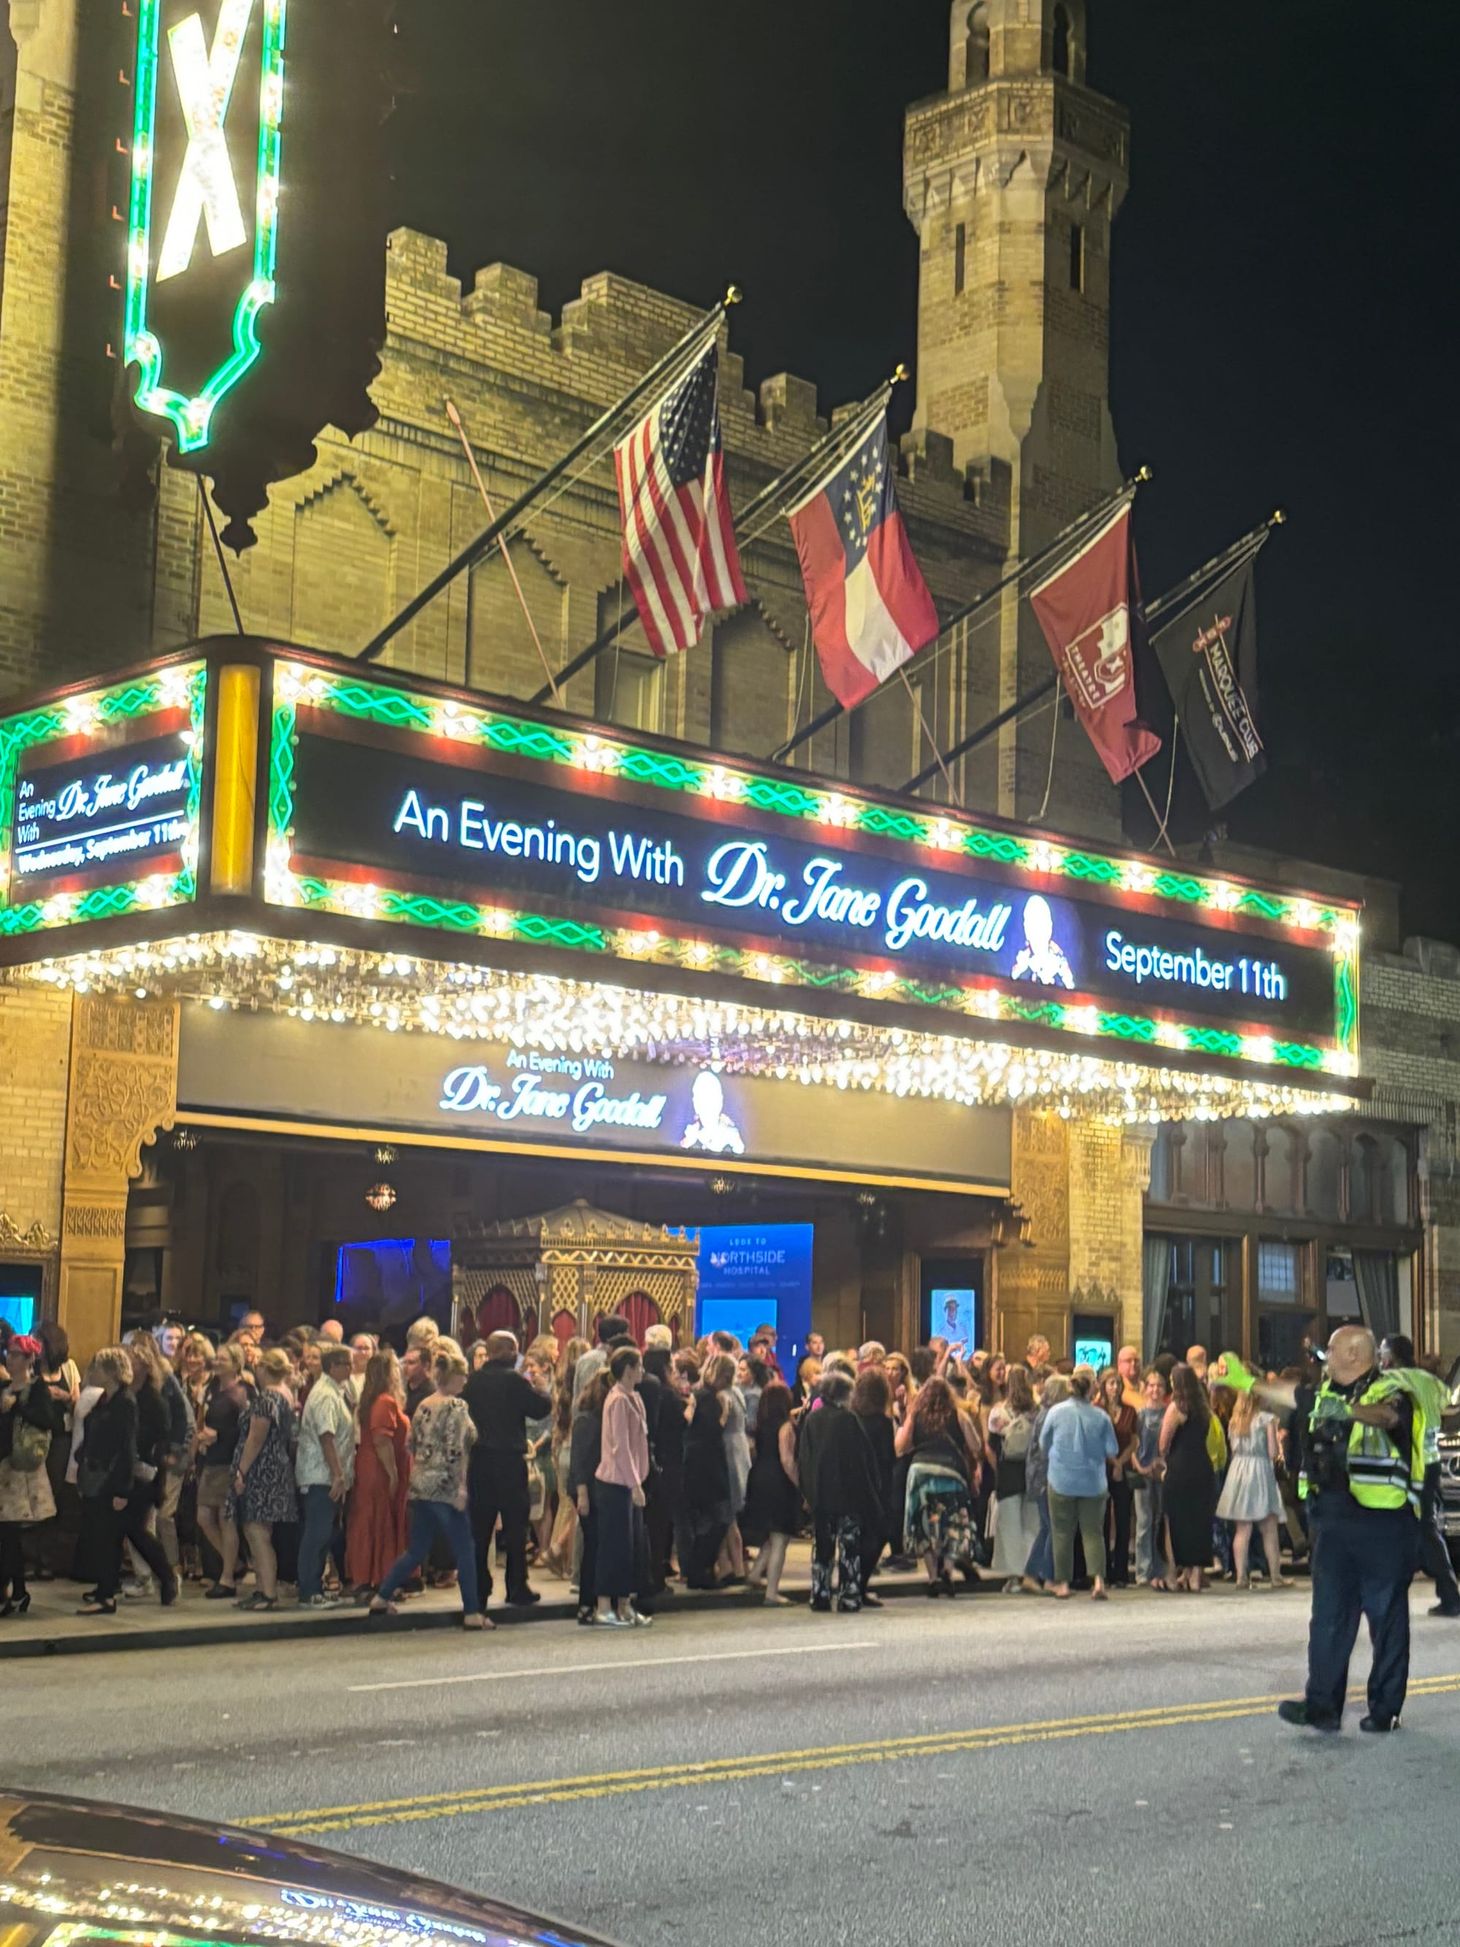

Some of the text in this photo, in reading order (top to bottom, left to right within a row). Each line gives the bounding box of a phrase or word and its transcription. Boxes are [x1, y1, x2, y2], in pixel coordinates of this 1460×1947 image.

[155, 0, 251, 283] X
[1071, 646, 1102, 700] THEATRE
[18, 780, 35, 799] An
[18, 799, 56, 822] Evening
[17, 821, 40, 844] With
[86, 827, 152, 862] September
[394, 790, 1287, 1001] An Evening With Dr. Jane Goodall September 11th
[507, 1049, 615, 1081] An Evening With
[439, 1065, 668, 1133] Dr. Jane Goodall
[710, 1250, 786, 1265] NORTHSIDE
[723, 1266, 771, 1276] HOSPITAL
